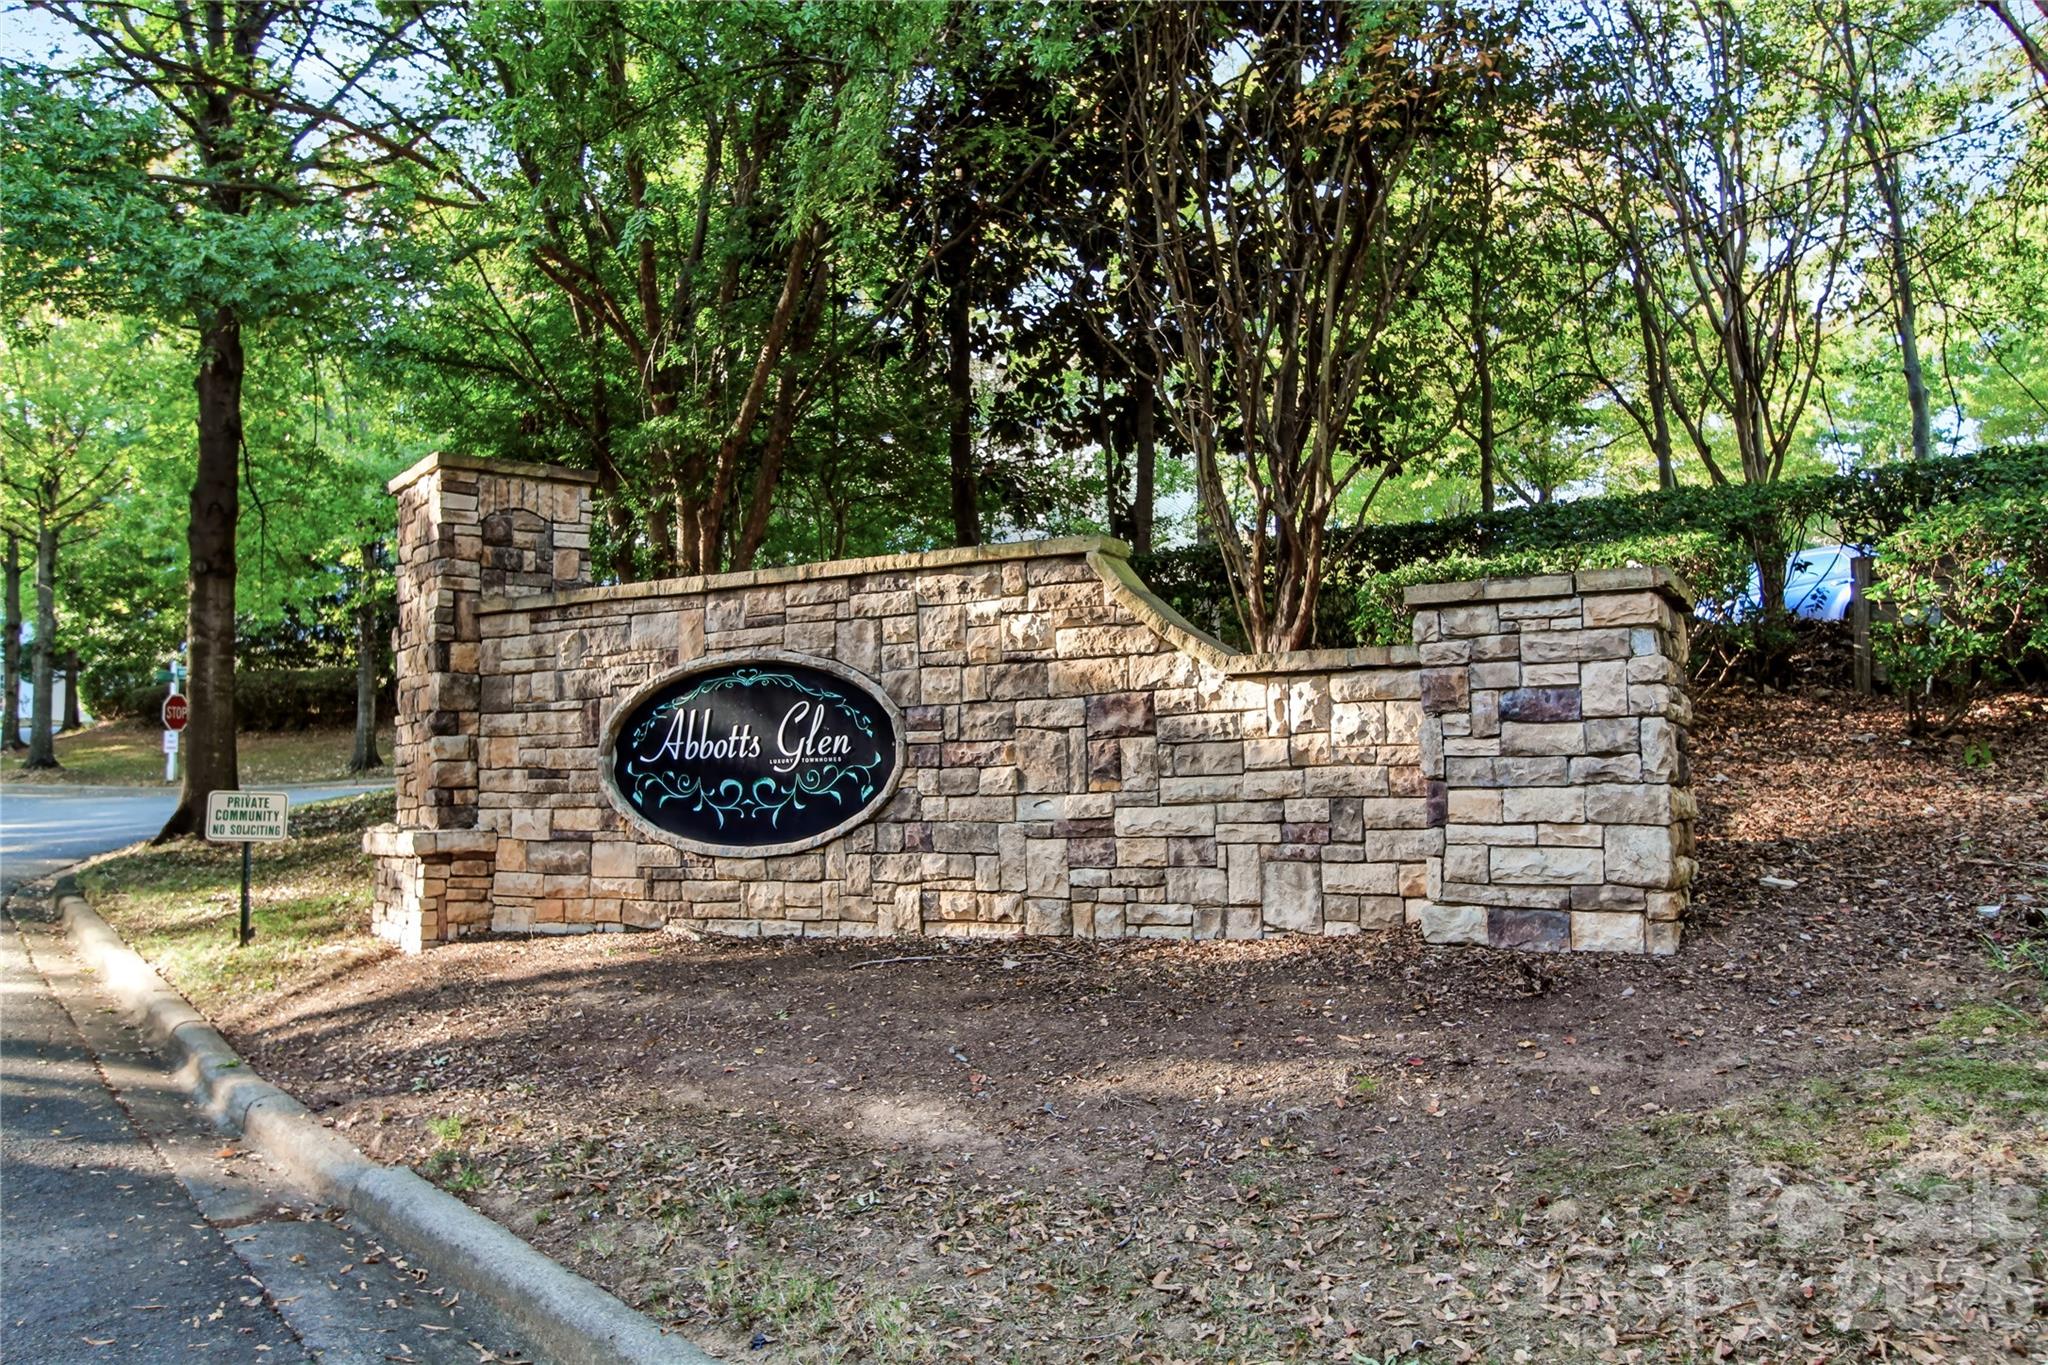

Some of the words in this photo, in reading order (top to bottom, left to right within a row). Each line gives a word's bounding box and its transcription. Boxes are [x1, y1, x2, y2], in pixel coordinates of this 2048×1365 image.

[166, 705, 188, 720] STOP
[639, 708, 762, 761] Abbotts
[774, 700, 852, 773] Glen
[769, 757, 794, 765] LUXURY
[227, 796, 270, 809] PRIVATE
[215, 809, 280, 822] COMMUNITY
[212, 824, 225, 835] NO
[230, 824, 281, 836] SOLICITING
